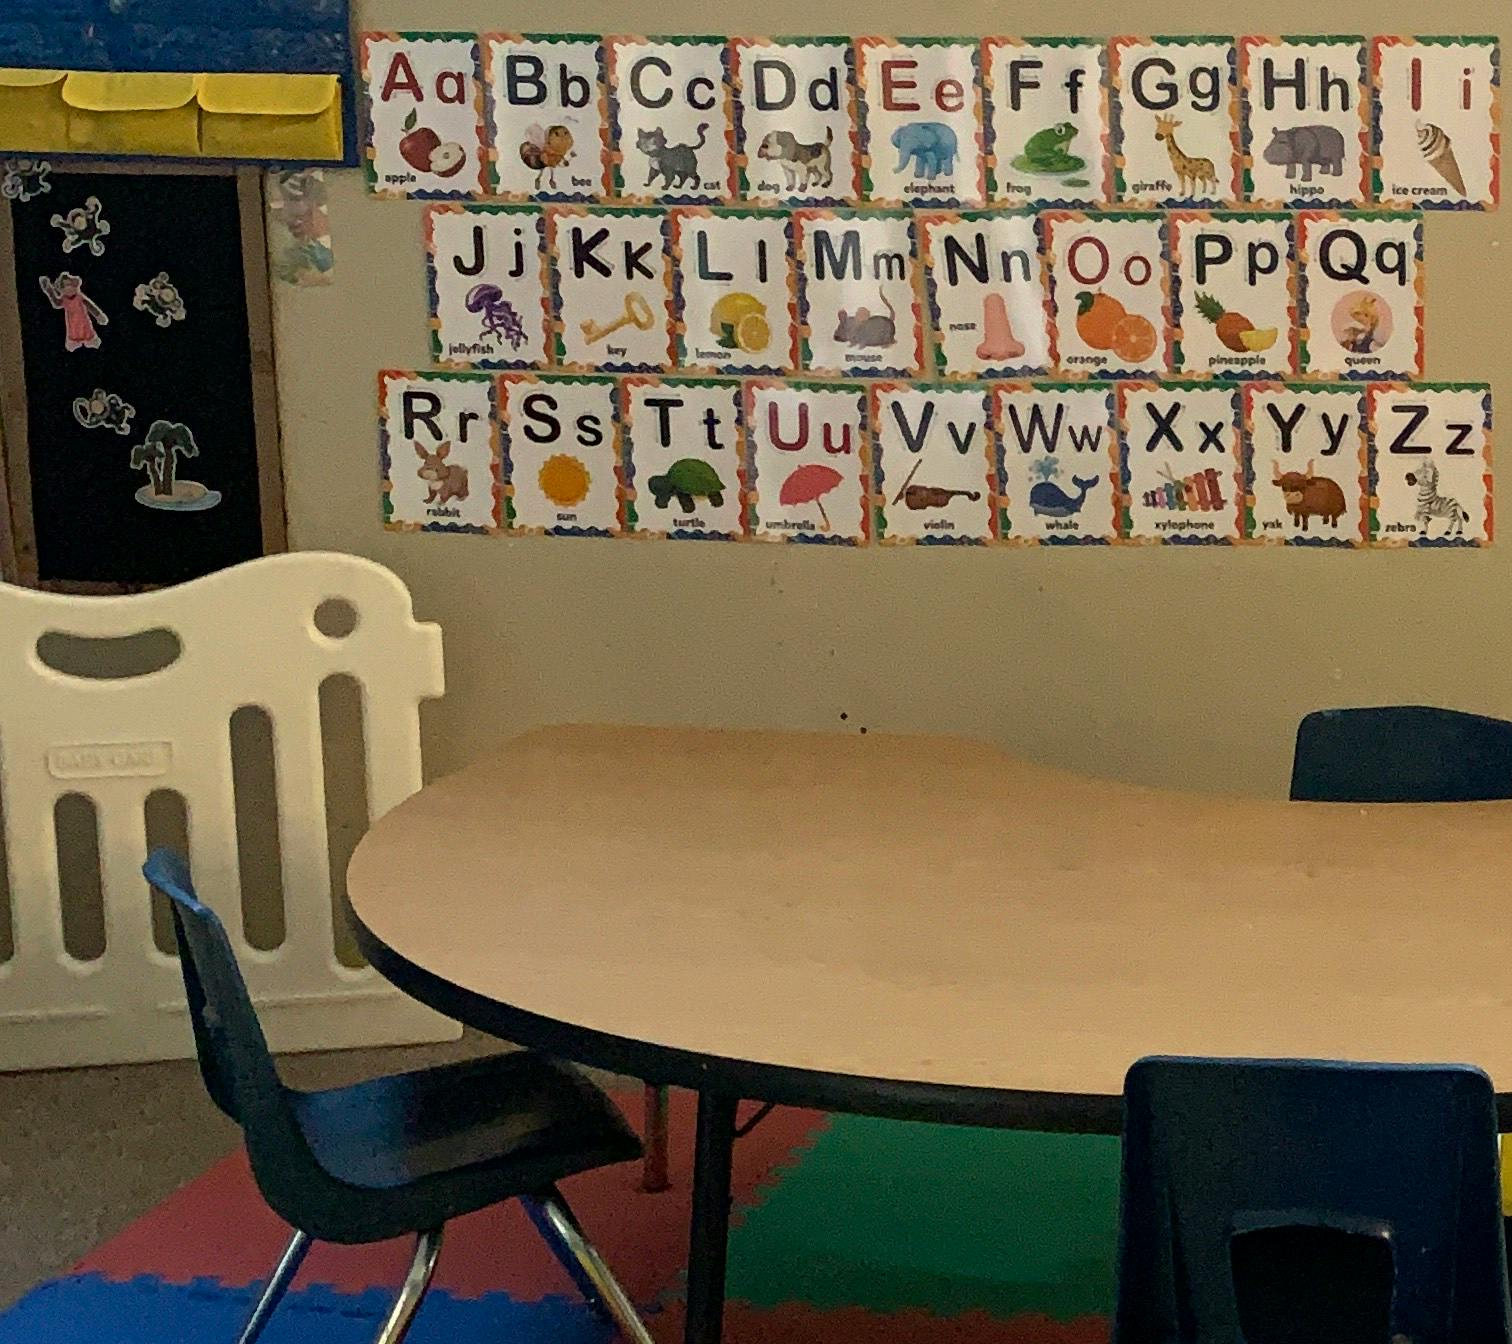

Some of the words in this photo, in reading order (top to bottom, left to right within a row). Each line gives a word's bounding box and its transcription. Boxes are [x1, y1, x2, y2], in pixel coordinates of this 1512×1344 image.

[385, 173, 417, 185] apple
[572, 176, 592, 187] bee
[703, 180, 721, 190] cat
[757, 180, 780, 194] dog
[903, 183, 955, 197] elephant
[1006, 181, 1032, 196] frog
[1132, 181, 1173, 194] giraffe
[1290, 183, 1325, 196] hippo
[1391, 184, 1409, 196] ice
[1411, 186, 1448, 196] cream
[949, 322, 977, 331] nose
[449, 343, 494, 356] jellyfish
[607, 344, 627, 358] key
[695, 348, 732, 360] lemon
[845, 353, 883, 362] mouse
[1066, 356, 1108, 367] orange
[1208, 354, 1266, 367] pineapple
[1344, 356, 1381, 367] queen
[426, 506, 461, 519] rabbit
[556, 512, 577, 522] sun
[673, 517, 706, 528] turtle
[766, 519, 815, 531] umbrella
[923, 519, 955, 531] violin
[1046, 519, 1079, 531] whale
[1155, 519, 1215, 531] xylophone
[1262, 520, 1283, 531] yak
[1385, 522, 1416, 533] zebra
